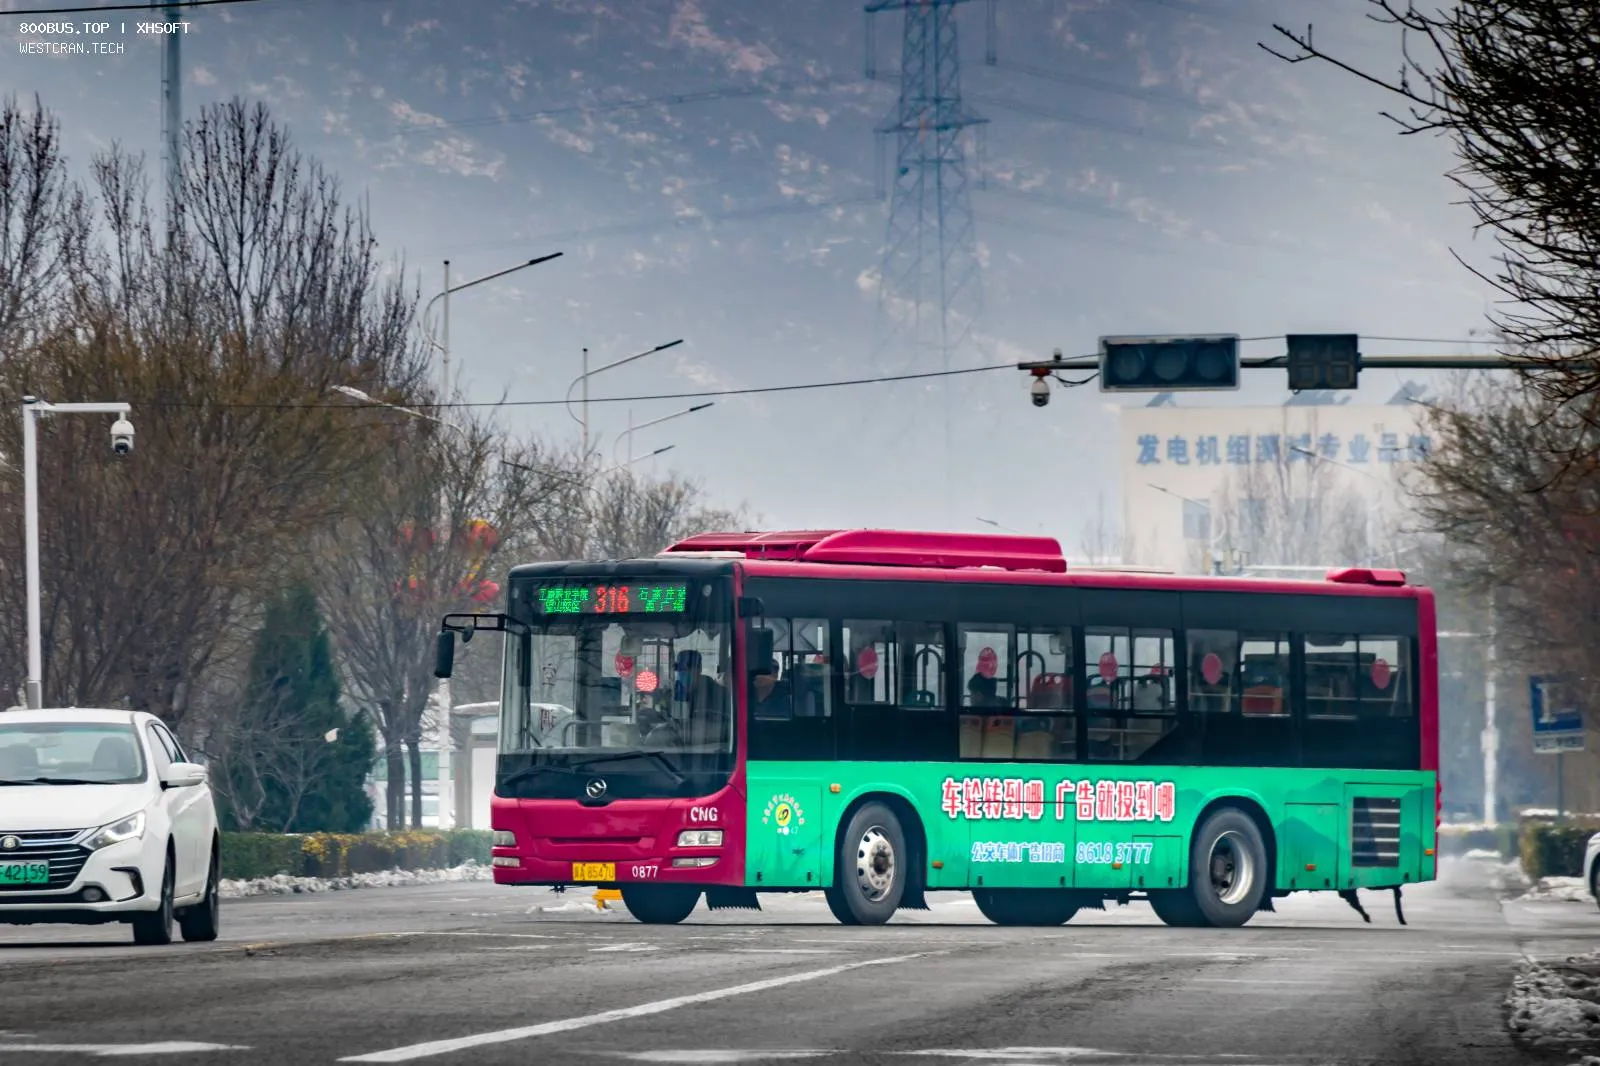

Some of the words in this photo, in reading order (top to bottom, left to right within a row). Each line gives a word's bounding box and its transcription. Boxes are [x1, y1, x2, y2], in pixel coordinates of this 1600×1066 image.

[594, 586, 631, 613] 316
[942, 777, 1044, 820] 车轮转到哪
[1055, 780, 1175, 821] 广告就投到哪
[690, 807, 718, 822] CNG
[1076, 842, 1111, 863] 8618
[1115, 842, 1153, 864] 3777
[631, 865, 659, 878] 0877
